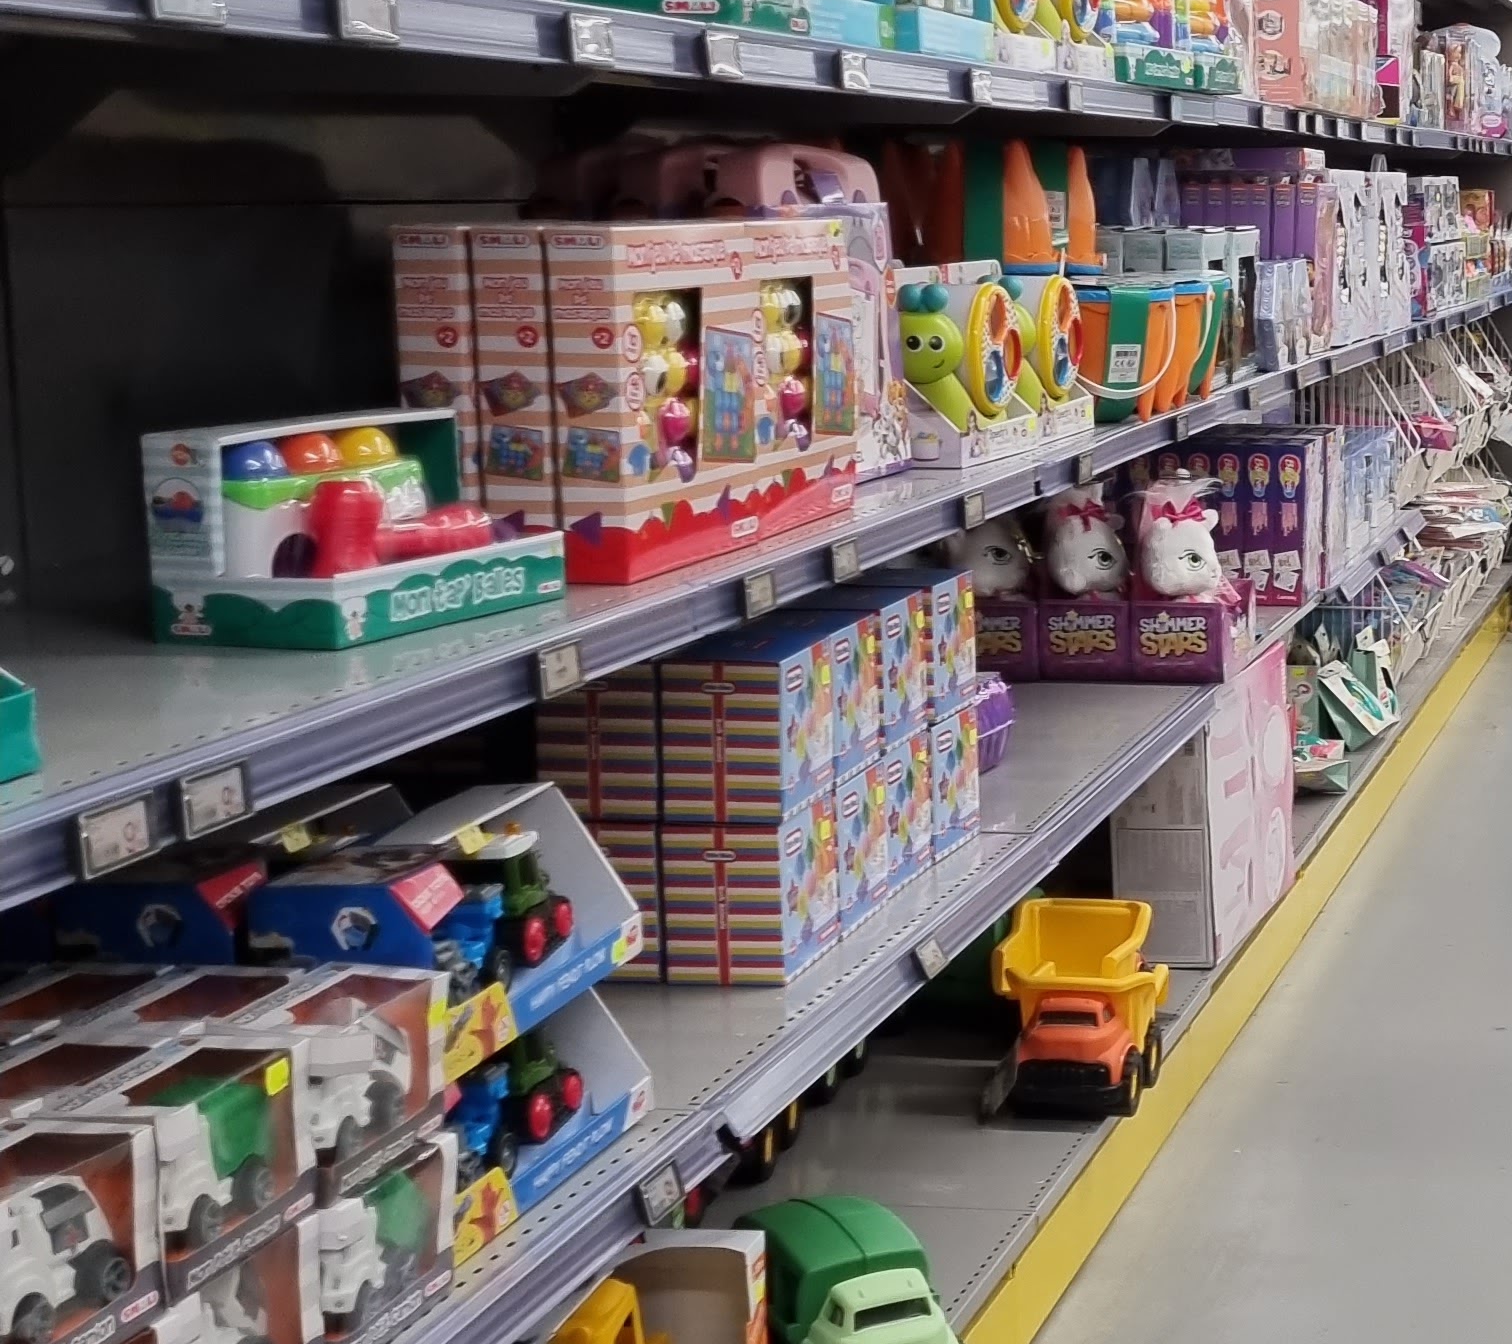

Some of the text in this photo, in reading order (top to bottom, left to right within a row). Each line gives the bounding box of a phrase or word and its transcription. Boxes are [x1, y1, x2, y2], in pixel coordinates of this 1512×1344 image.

[978, 616, 1022, 631] MMER
[1138, 613, 1208, 633] SHIMMER
[1050, 630, 1118, 657] STARS
[1139, 632, 1208, 658] STARS
